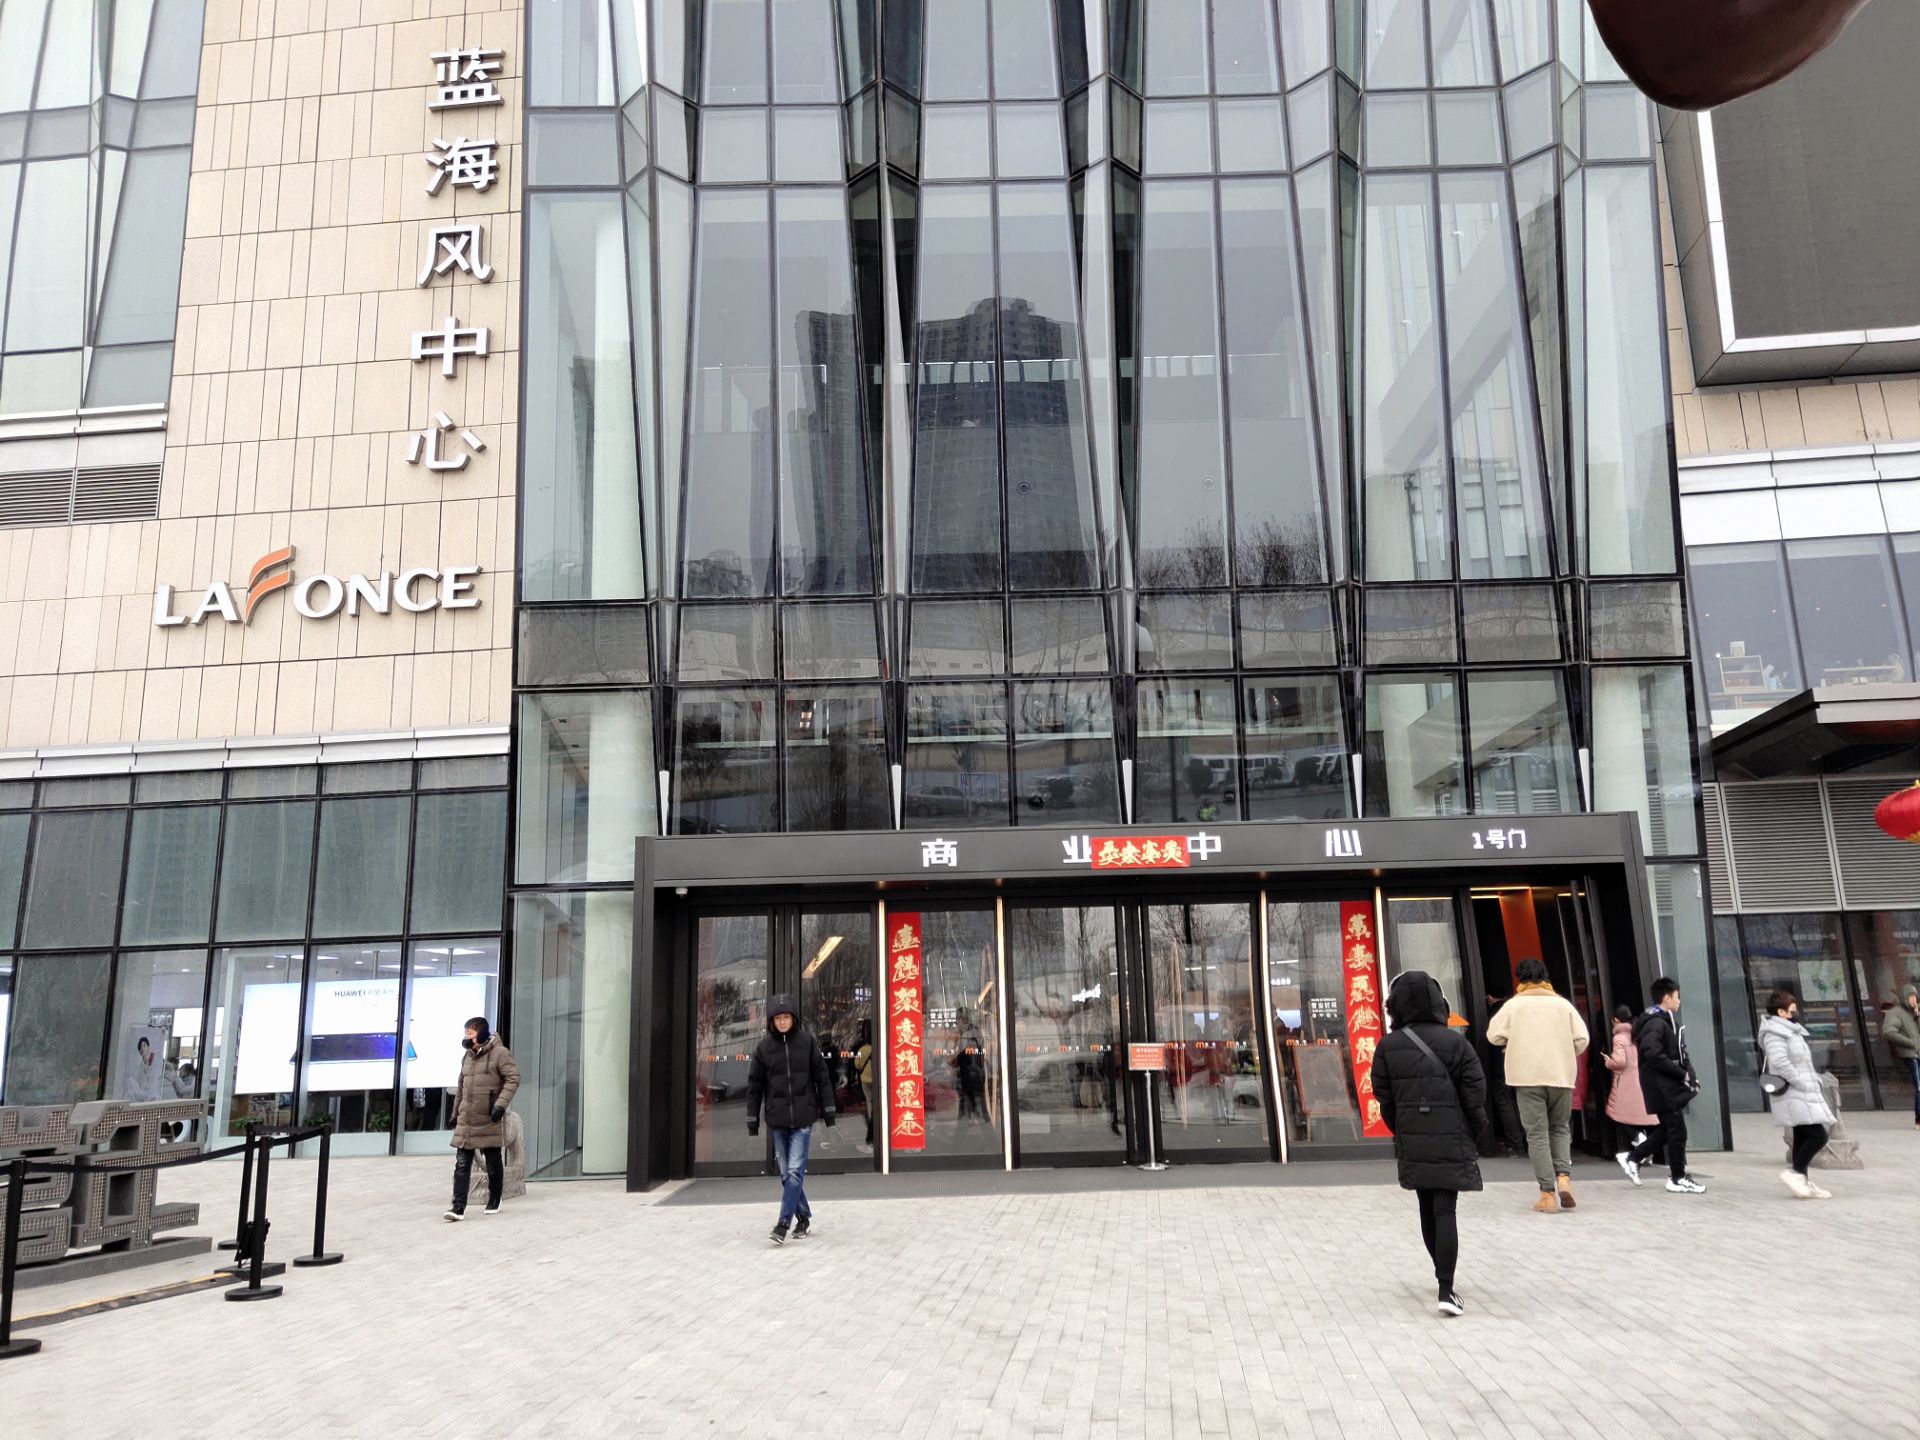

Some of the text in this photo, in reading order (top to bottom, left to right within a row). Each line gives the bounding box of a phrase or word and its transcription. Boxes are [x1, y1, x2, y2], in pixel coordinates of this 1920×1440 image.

[406, 46, 504, 471] 蓝海风中心
[1472, 829, 1527, 849] 1号门
[334, 989, 366, 998] HUAWEI
